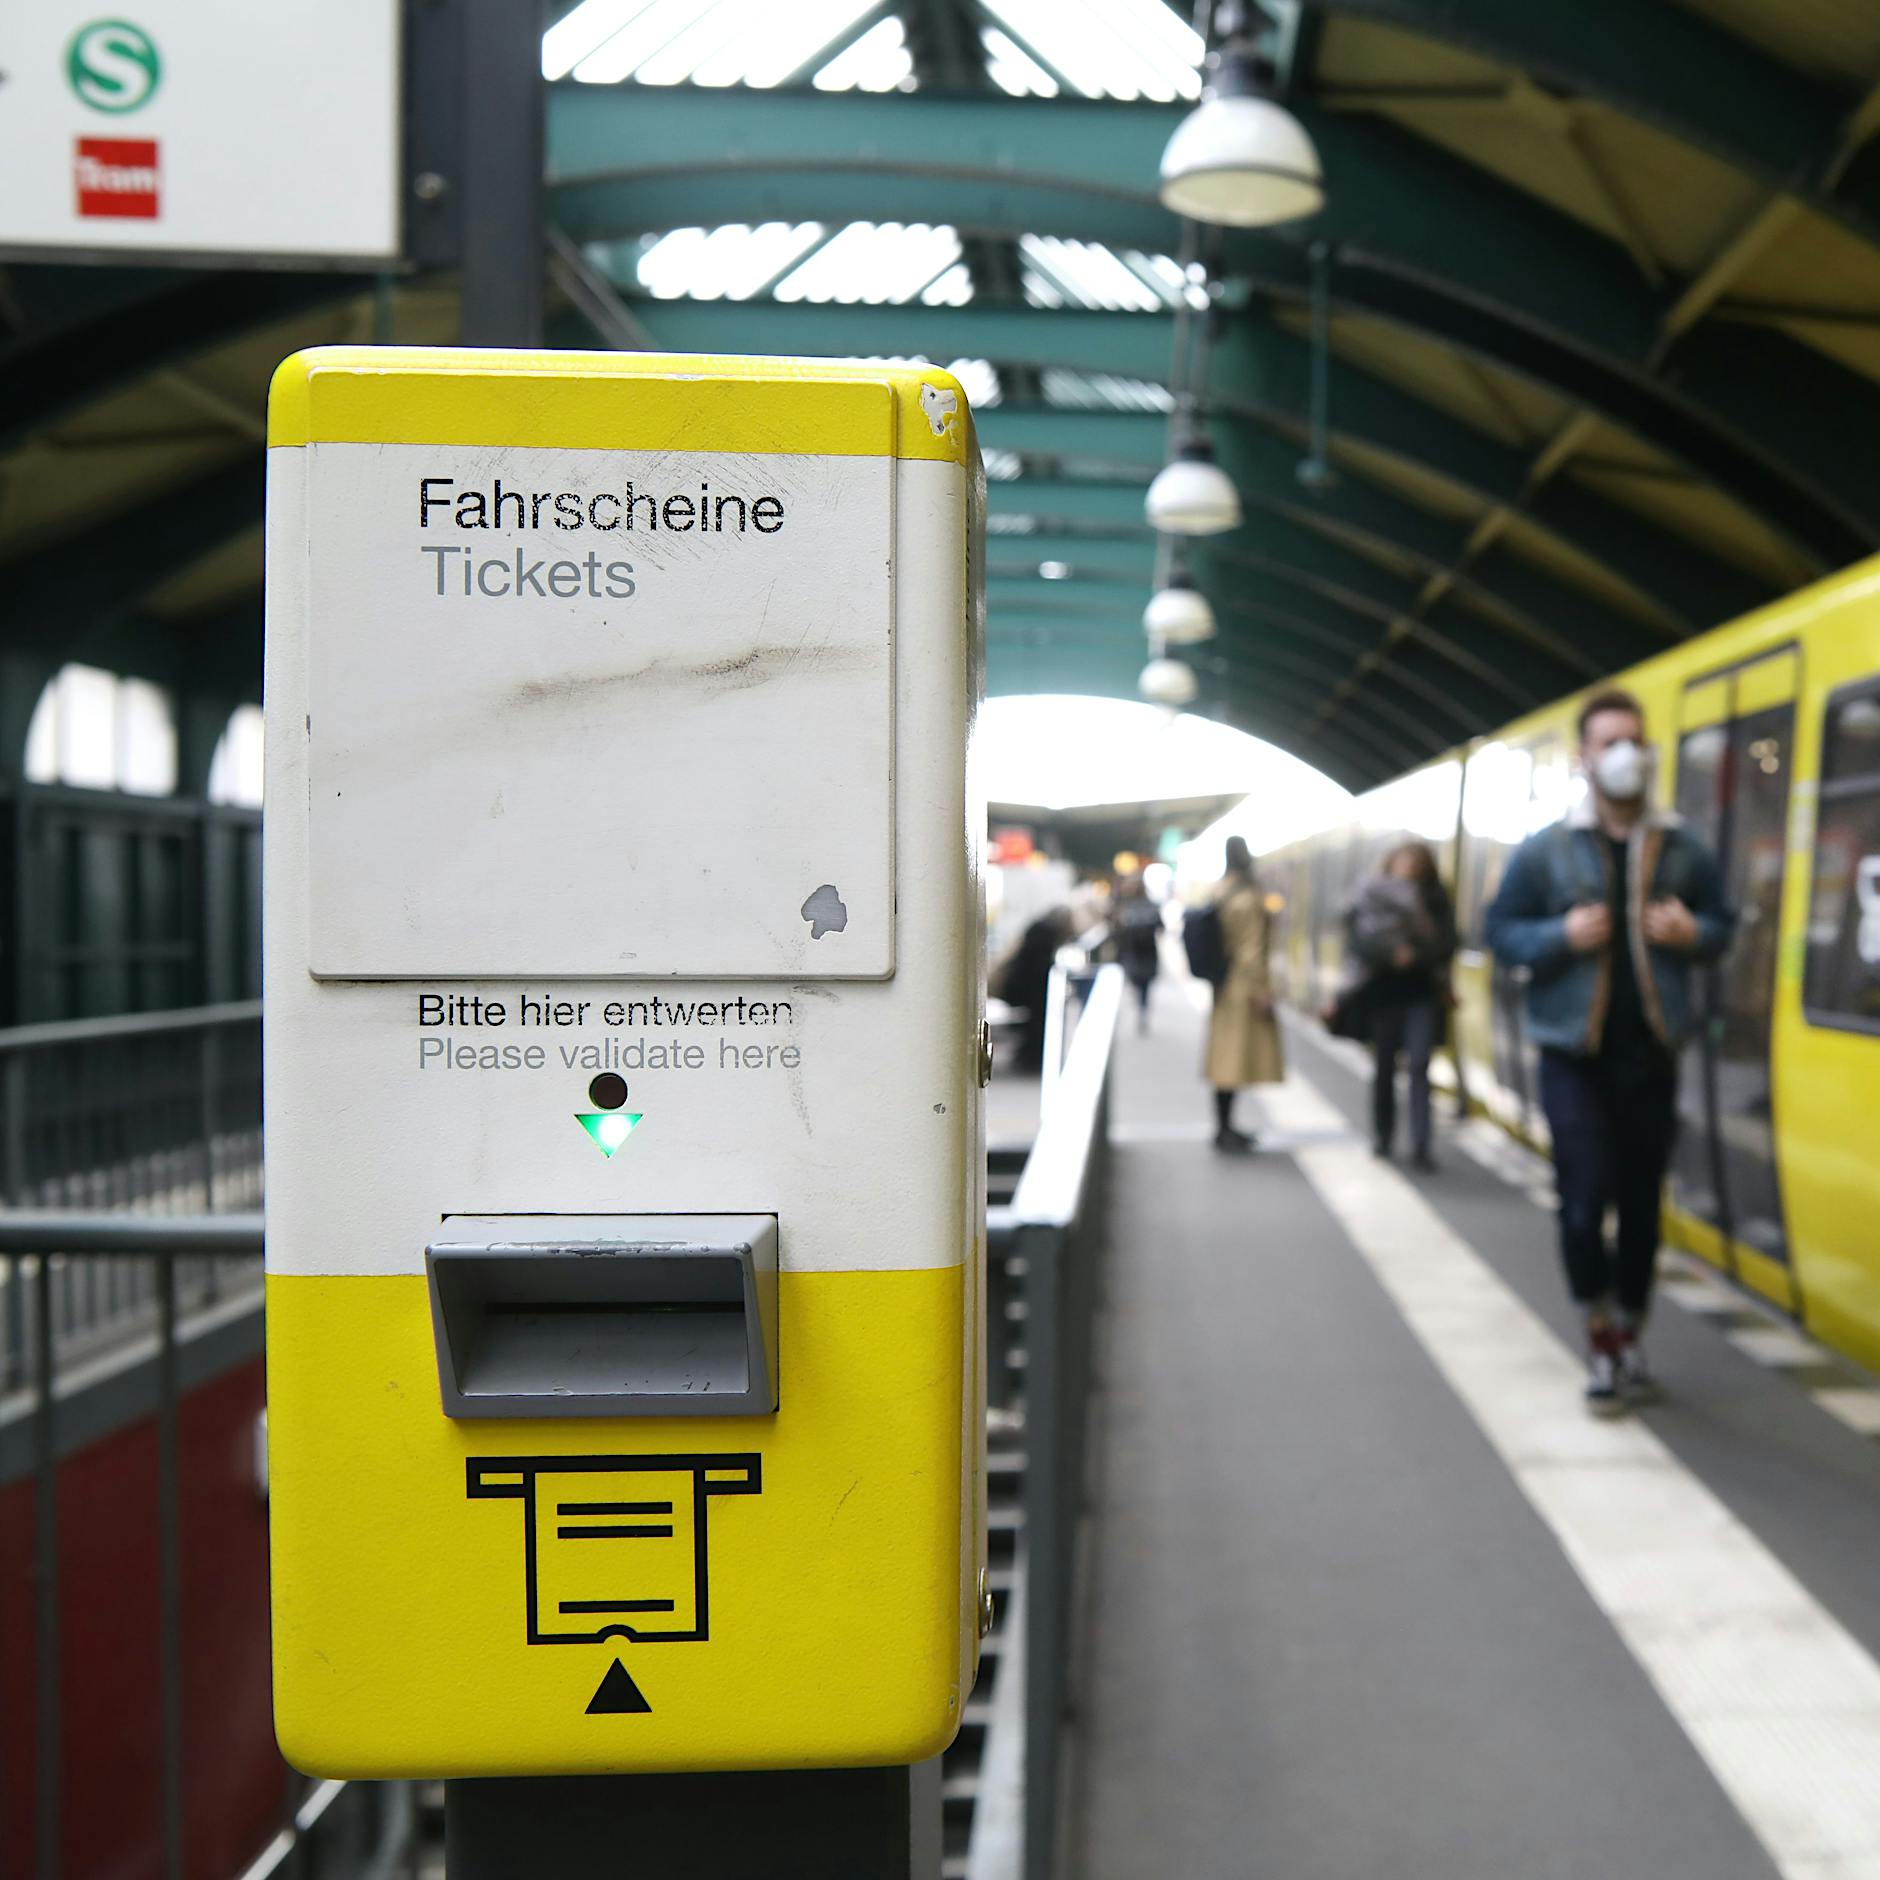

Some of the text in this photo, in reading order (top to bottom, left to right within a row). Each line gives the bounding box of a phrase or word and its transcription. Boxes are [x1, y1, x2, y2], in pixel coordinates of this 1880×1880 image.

[77, 27, 152, 108] S
[77, 155, 157, 192] Tram
[420, 477, 785, 534] Fahrscheine
[420, 545, 637, 599] Tickets
[418, 993, 794, 1027] Bitte hier entwerten
[418, 1037, 802, 1070] Please validate here
